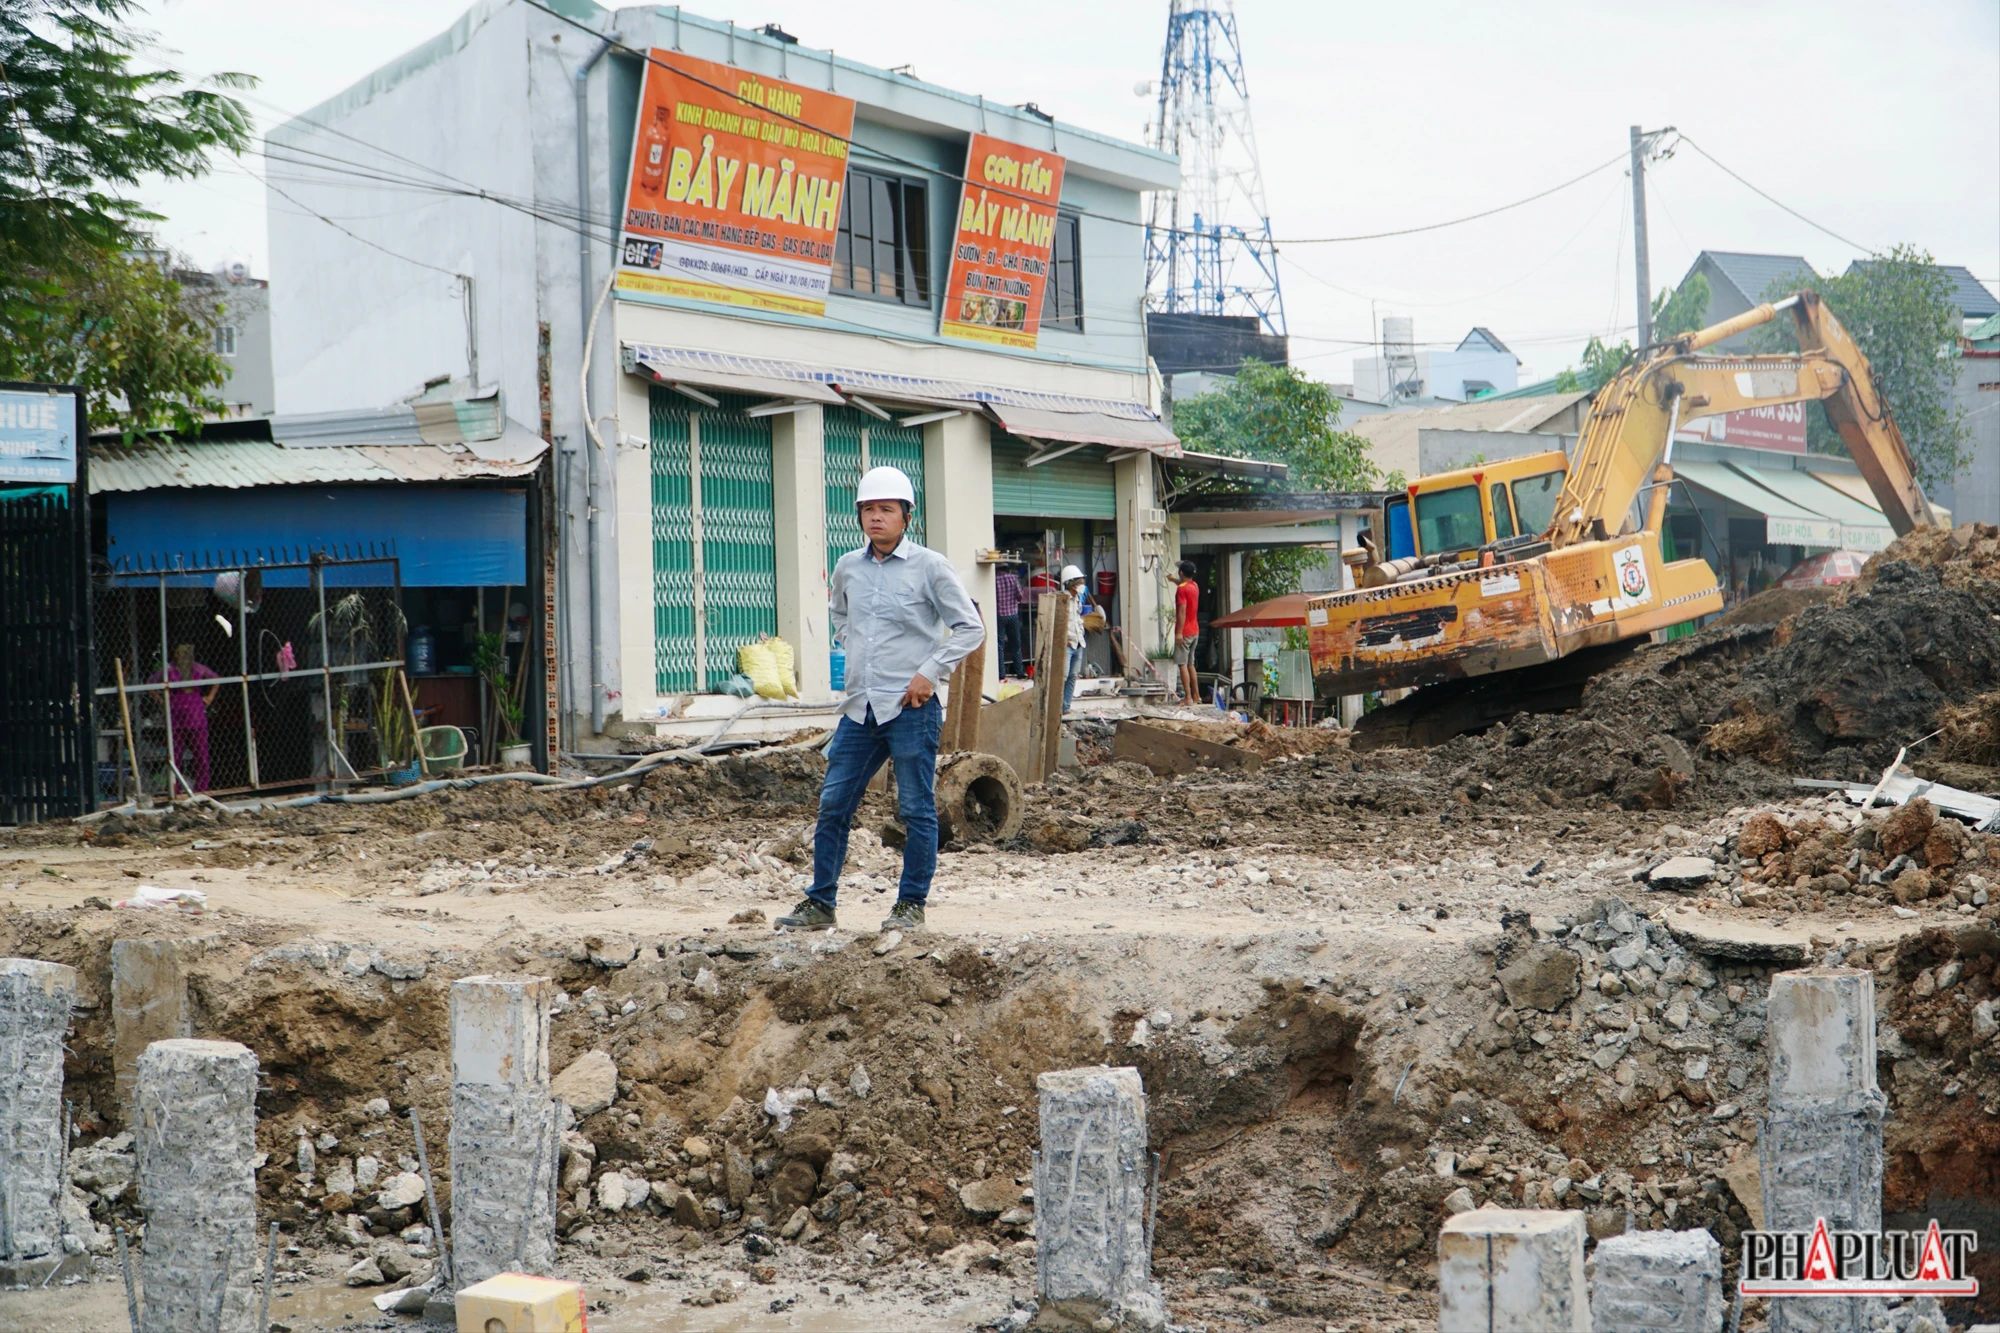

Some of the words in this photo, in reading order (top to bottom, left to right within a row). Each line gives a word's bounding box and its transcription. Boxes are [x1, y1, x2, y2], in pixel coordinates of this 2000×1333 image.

[738, 76, 764, 107] CỬA
[768, 85, 802, 118] HÀNG
[676, 102, 703, 126] KINH
[704, 109, 741, 134] DOANH
[666, 134, 740, 210] BẢY
[742, 158, 840, 230] MÃNH
[1021, 158, 1053, 196] TẤM
[628, 209, 662, 230] CHUYÊN
[664, 212, 682, 233] BÁN
[683, 216, 700, 236] CÁC
[720, 222, 742, 246] HÀNG
[761, 233, 776, 250] GAS
[782, 238, 798, 254] GAS
[800, 238, 816, 257] CÁC
[961, 189, 1000, 236] BẢY
[1000, 203, 1054, 248] MÃNH
[624, 242, 648, 264] elf
[957, 242, 981, 262] SƯỜN
[770, 269, 788, 284] NGÀY
